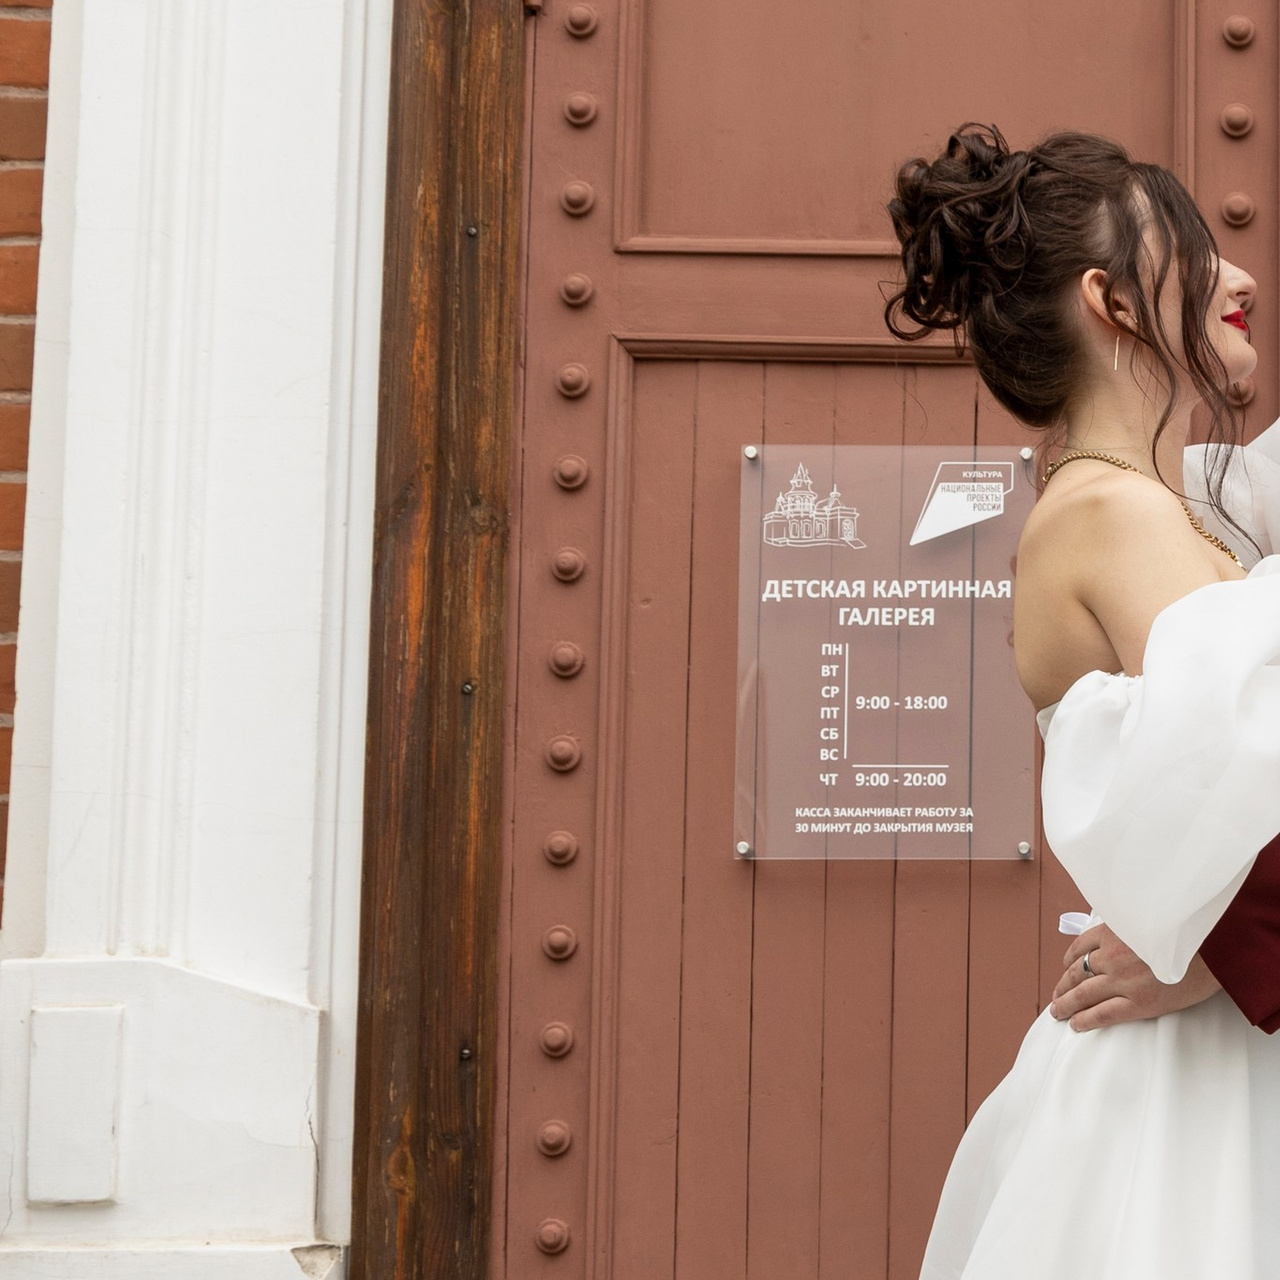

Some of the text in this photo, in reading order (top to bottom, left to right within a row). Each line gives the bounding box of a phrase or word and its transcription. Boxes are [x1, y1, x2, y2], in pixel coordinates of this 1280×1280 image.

[973, 503, 1001, 511] РОССИИ
[762, 580, 1011, 602] ДЕТСКАЯ КАРТИННАЯ
[839, 608, 935, 626] ГАЛЕРЕЯ
[821, 644, 843, 655] ПН
[821, 665, 839, 677] ВТ
[821, 686, 839, 698] СР
[856, 696, 890, 709] 9:00
[905, 696, 948, 709] 18:00
[820, 707, 839, 719] ПТ
[820, 728, 839, 740] СБ
[820, 749, 838, 760] ВС
[820, 773, 838, 786] ЧТ
[855, 773, 889, 786] 9:00
[903, 773, 947, 786] 20:00
[795, 808, 973, 817] КАССА ЗАКАНЧИВАЕТ РАБОТУ ЗА
[795, 823, 973, 834] 30 МИНУТ ДО ЗАКРЫТИЯ МУЗЕЯ
